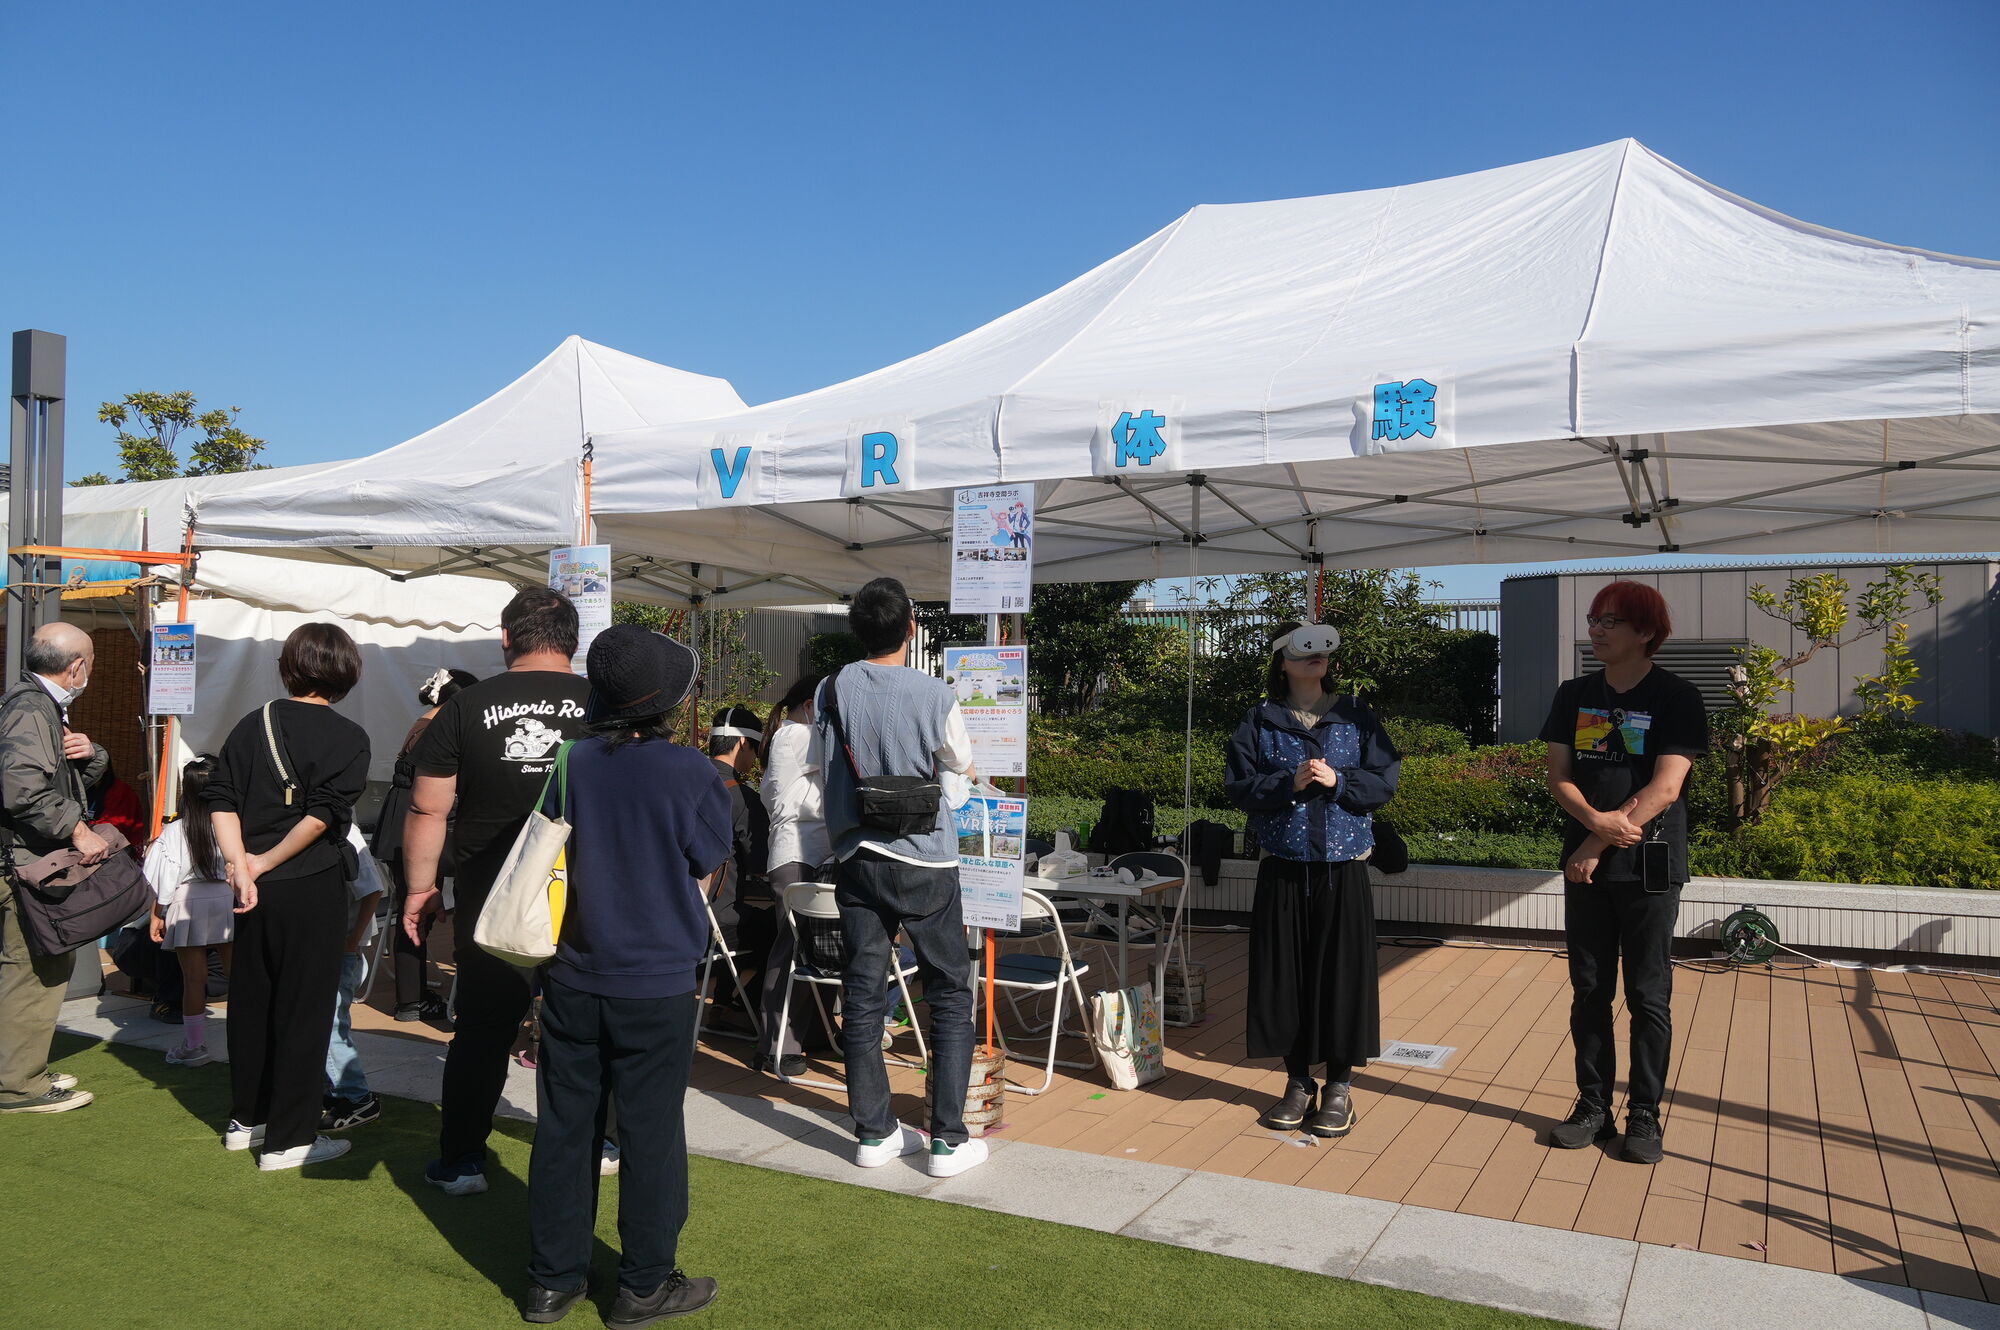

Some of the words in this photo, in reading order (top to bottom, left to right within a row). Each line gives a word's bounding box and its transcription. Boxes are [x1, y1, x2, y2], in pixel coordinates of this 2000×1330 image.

[977, 490, 1019, 499] 吉祥寺空間ラボ
[483, 700, 555, 730] Historic
[521, 764, 543, 774] Since
